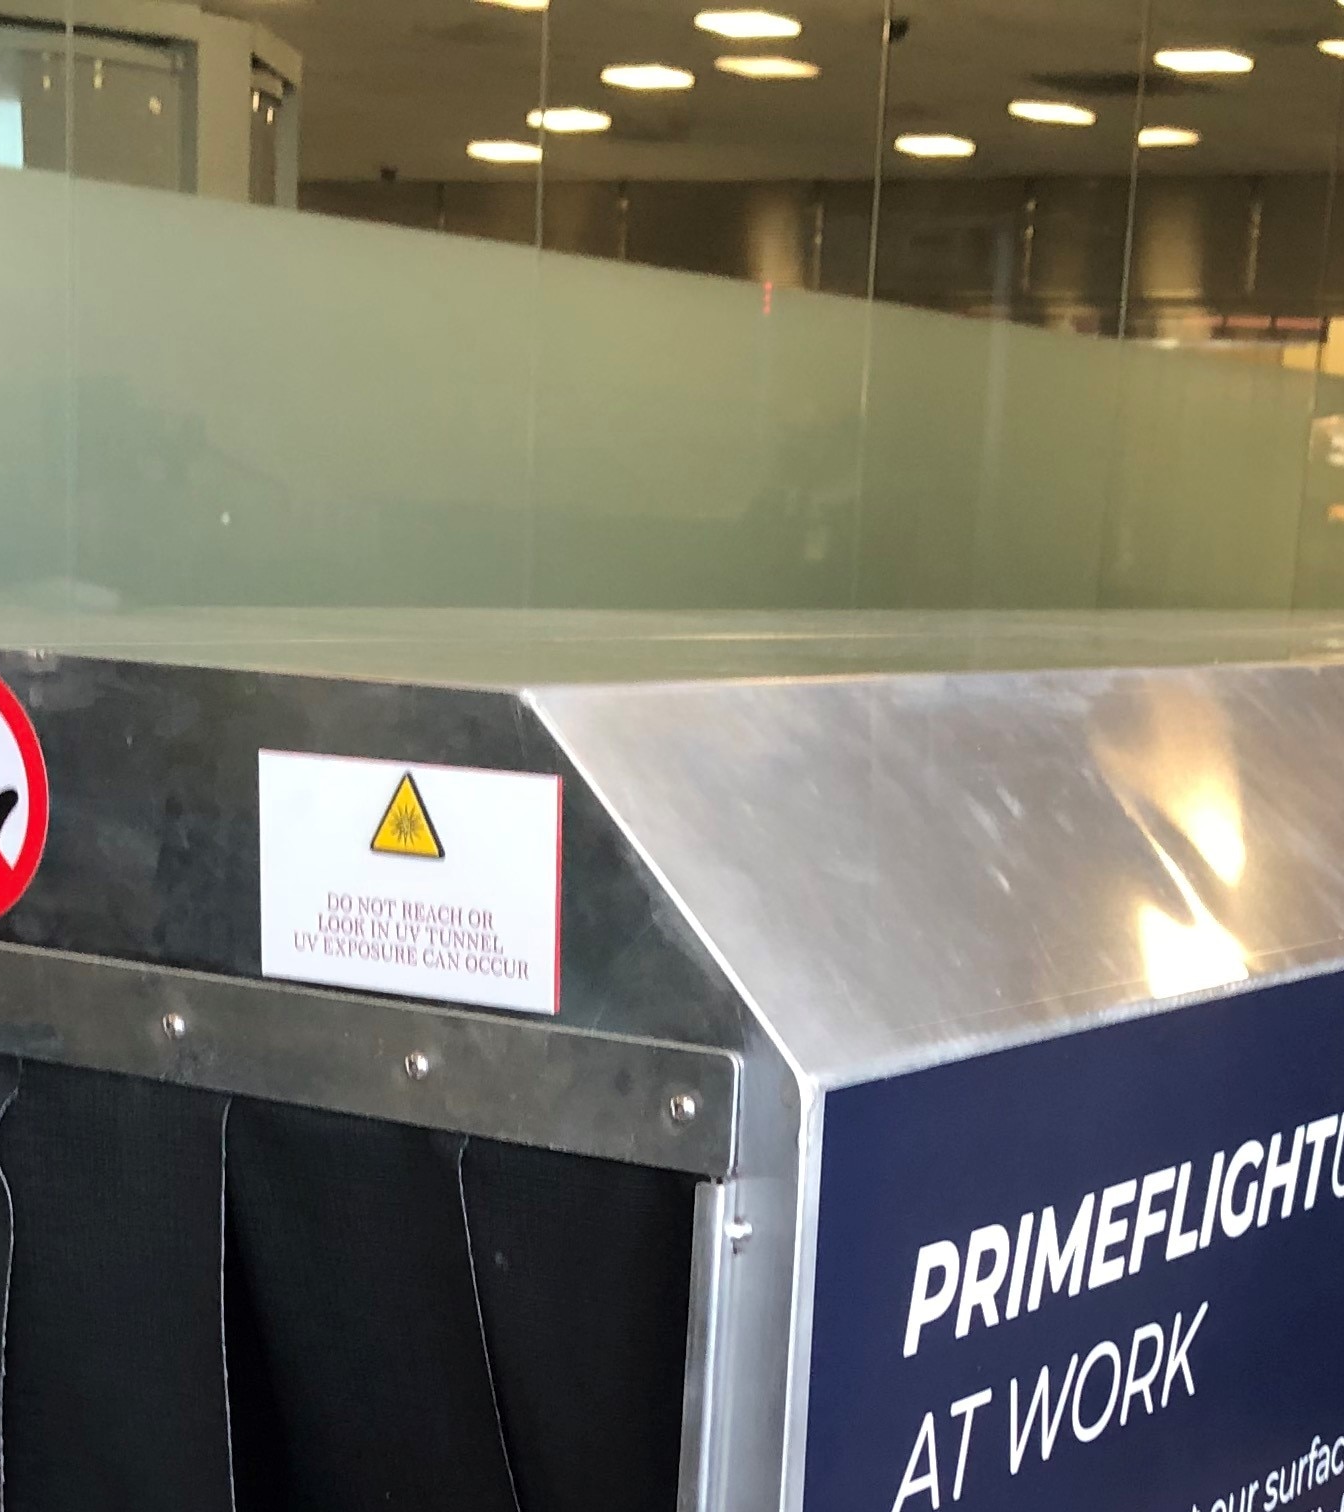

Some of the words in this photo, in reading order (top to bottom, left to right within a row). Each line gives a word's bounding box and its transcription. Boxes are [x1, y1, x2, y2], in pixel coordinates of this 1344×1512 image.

[318, 913, 365, 937] LOOK
[371, 920, 390, 940] IN
[396, 922, 420, 943] UV
[425, 926, 503, 955] TUNNEL
[327, 892, 353, 912] DO
[358, 896, 396, 919] NOT
[403, 901, 462, 928] REACH
[468, 908, 493, 931] OR
[294, 932, 318, 953] UV
[324, 934, 417, 967] EXPOSURE
[423, 947, 460, 972] CAN
[465, 953, 529, 981] OCCUR
[1009, 1301, 1209, 1475] WORK
